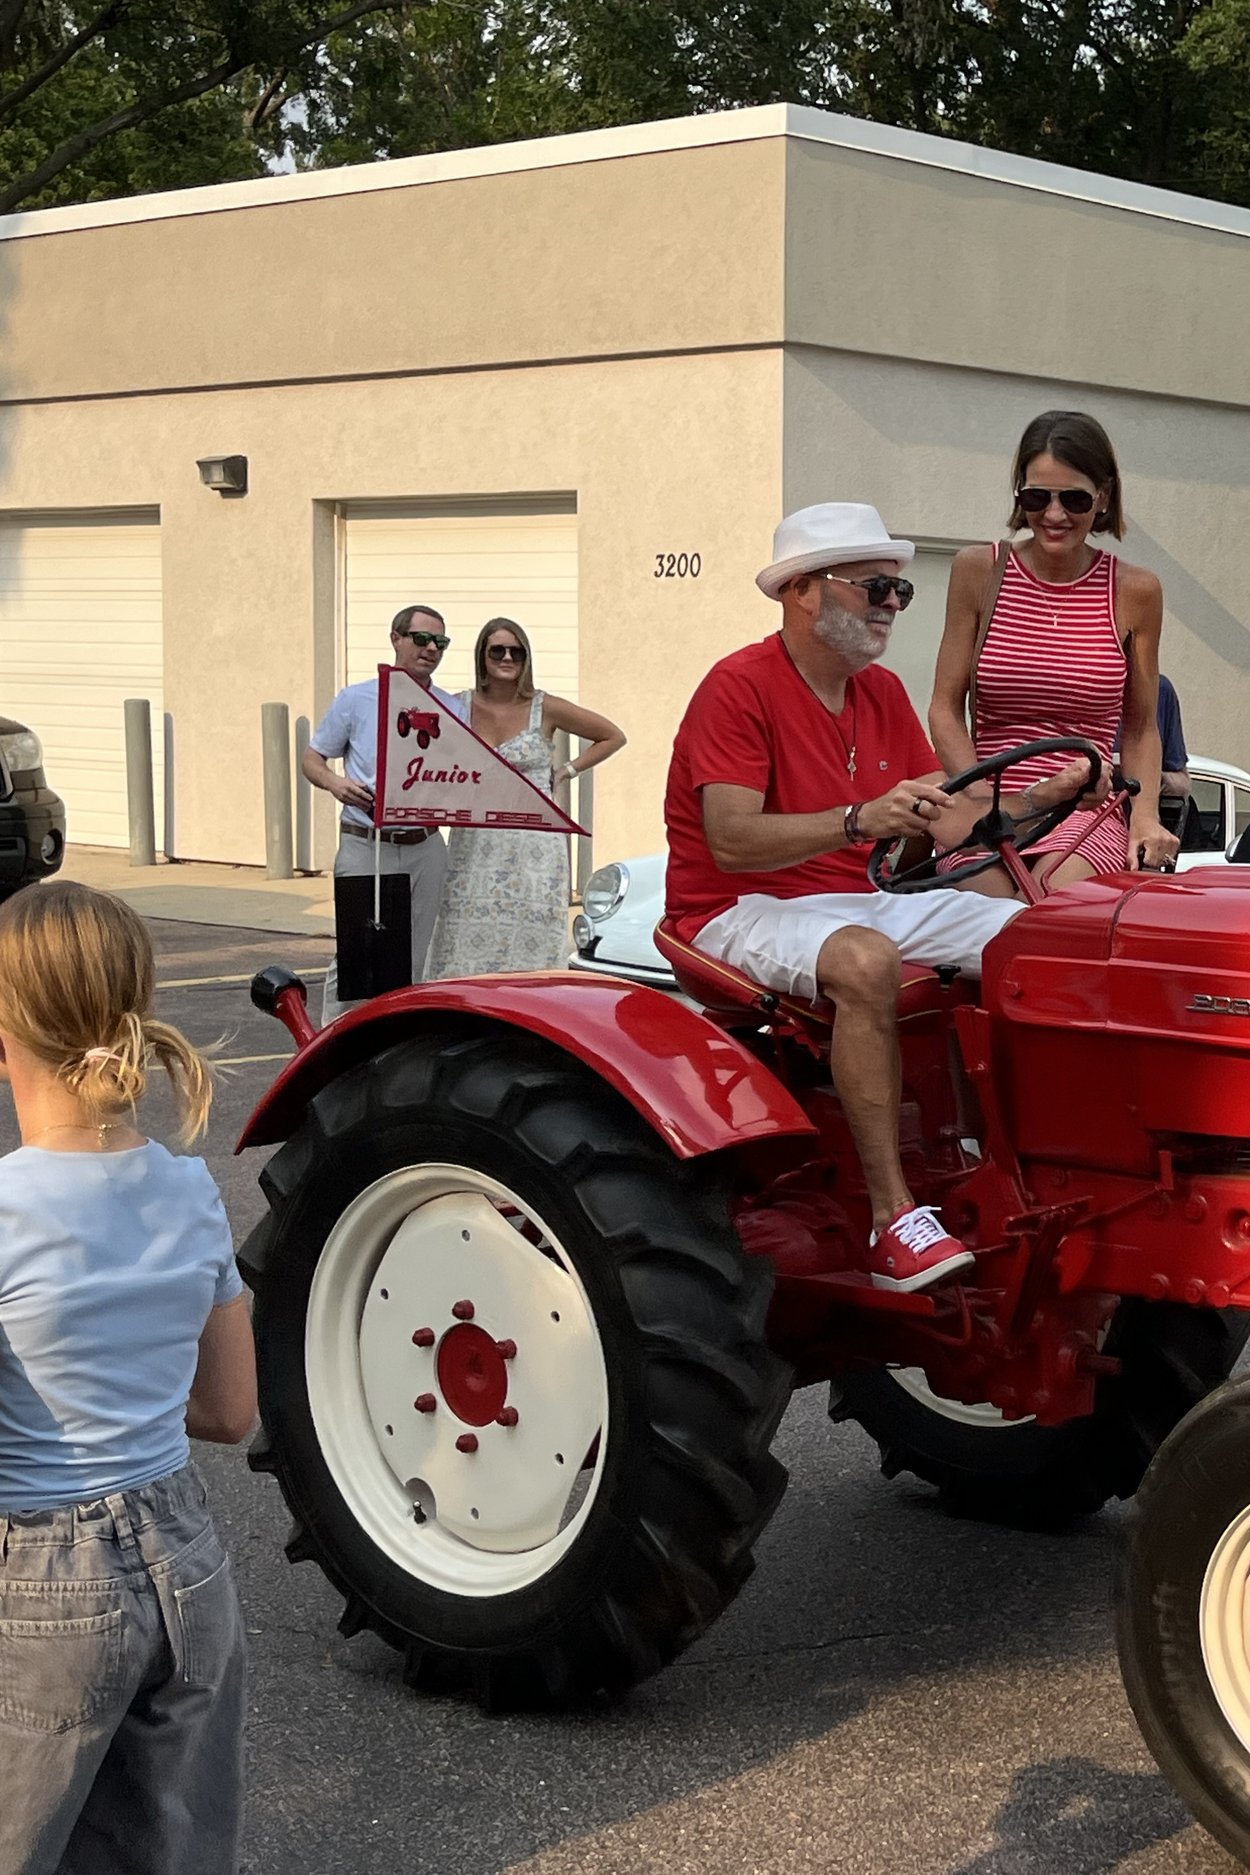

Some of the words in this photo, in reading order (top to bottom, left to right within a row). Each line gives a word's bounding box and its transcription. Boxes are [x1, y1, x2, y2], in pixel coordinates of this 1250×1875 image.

[653, 552, 702, 578] 3200
[401, 756, 482, 791] Junior
[385, 807, 473, 822] PORSCHE
